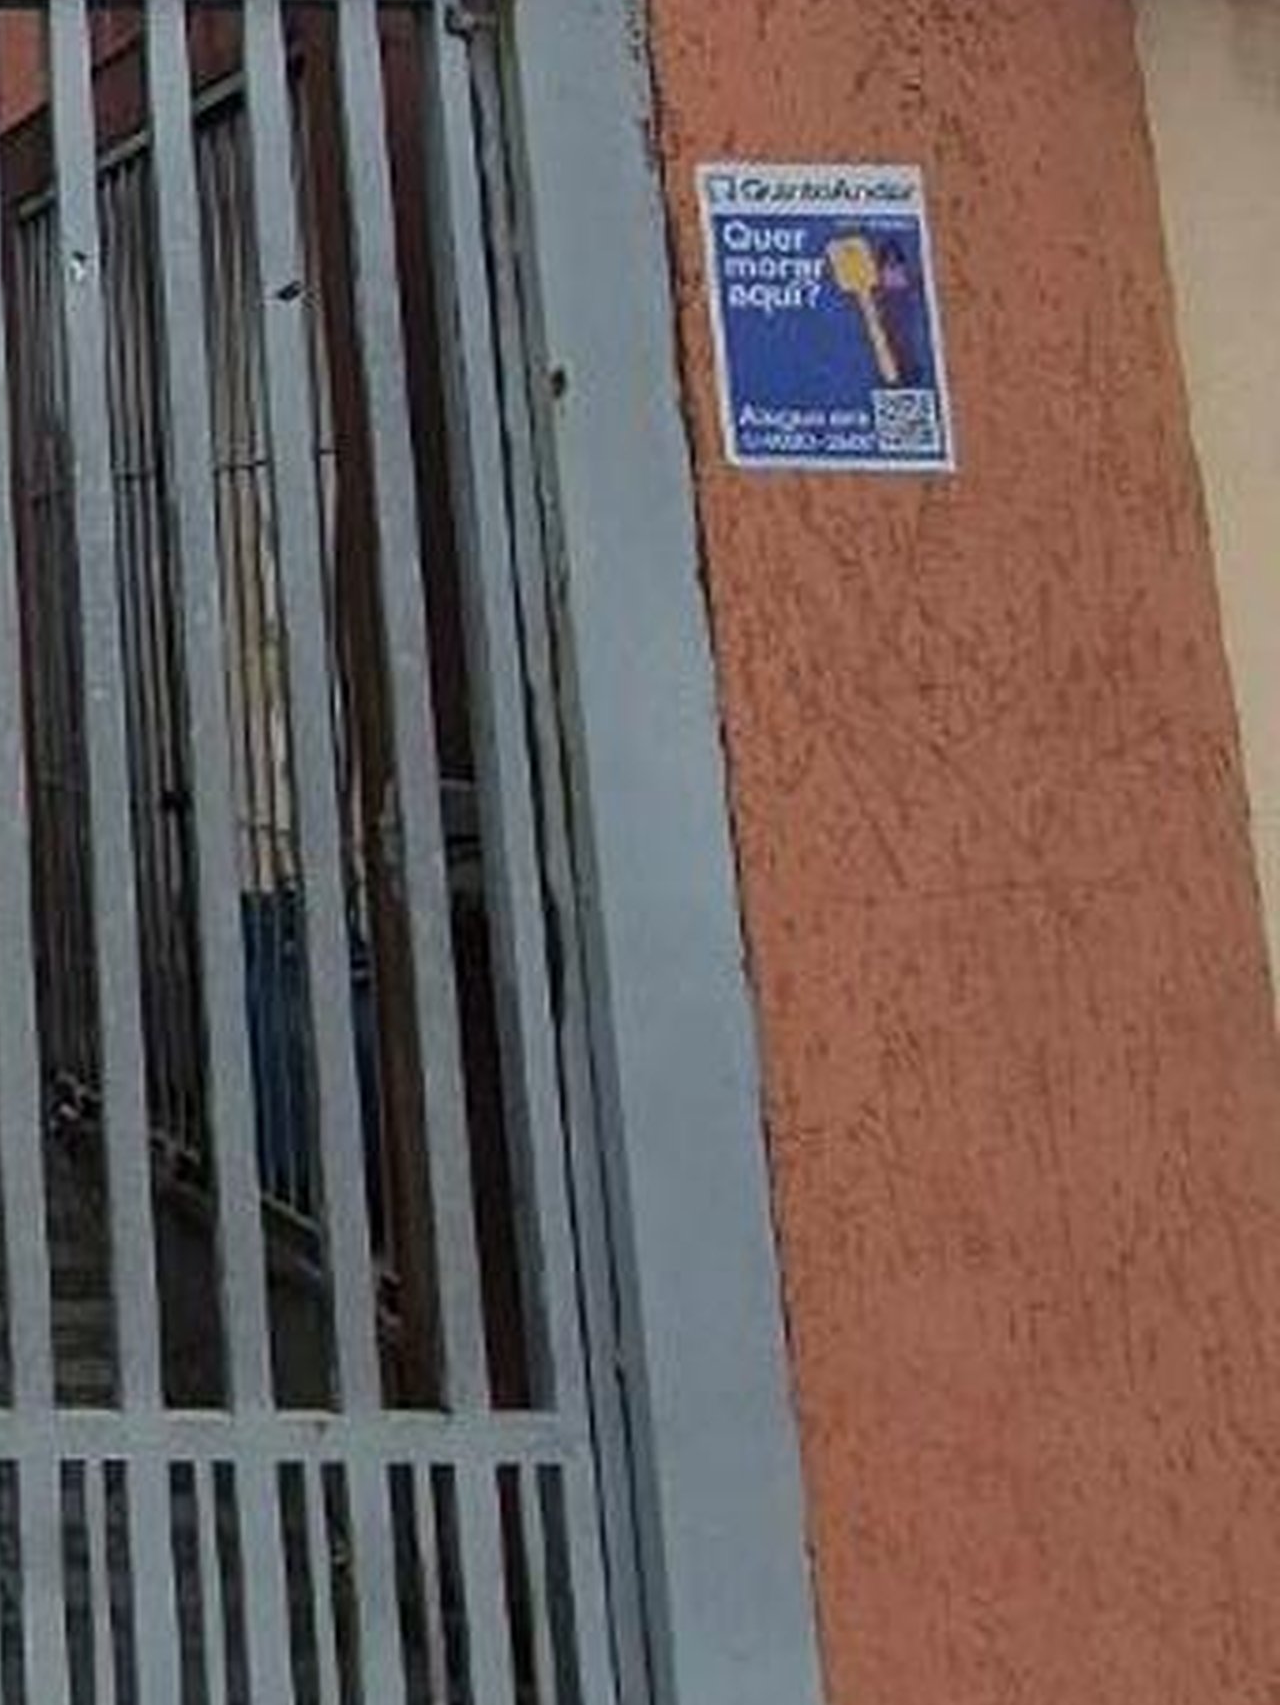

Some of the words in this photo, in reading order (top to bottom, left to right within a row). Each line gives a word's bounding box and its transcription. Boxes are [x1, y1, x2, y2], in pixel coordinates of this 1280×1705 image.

[724, 220, 806, 252] Quer
[725, 255, 823, 279] morar
[729, 281, 821, 315] aqui?
